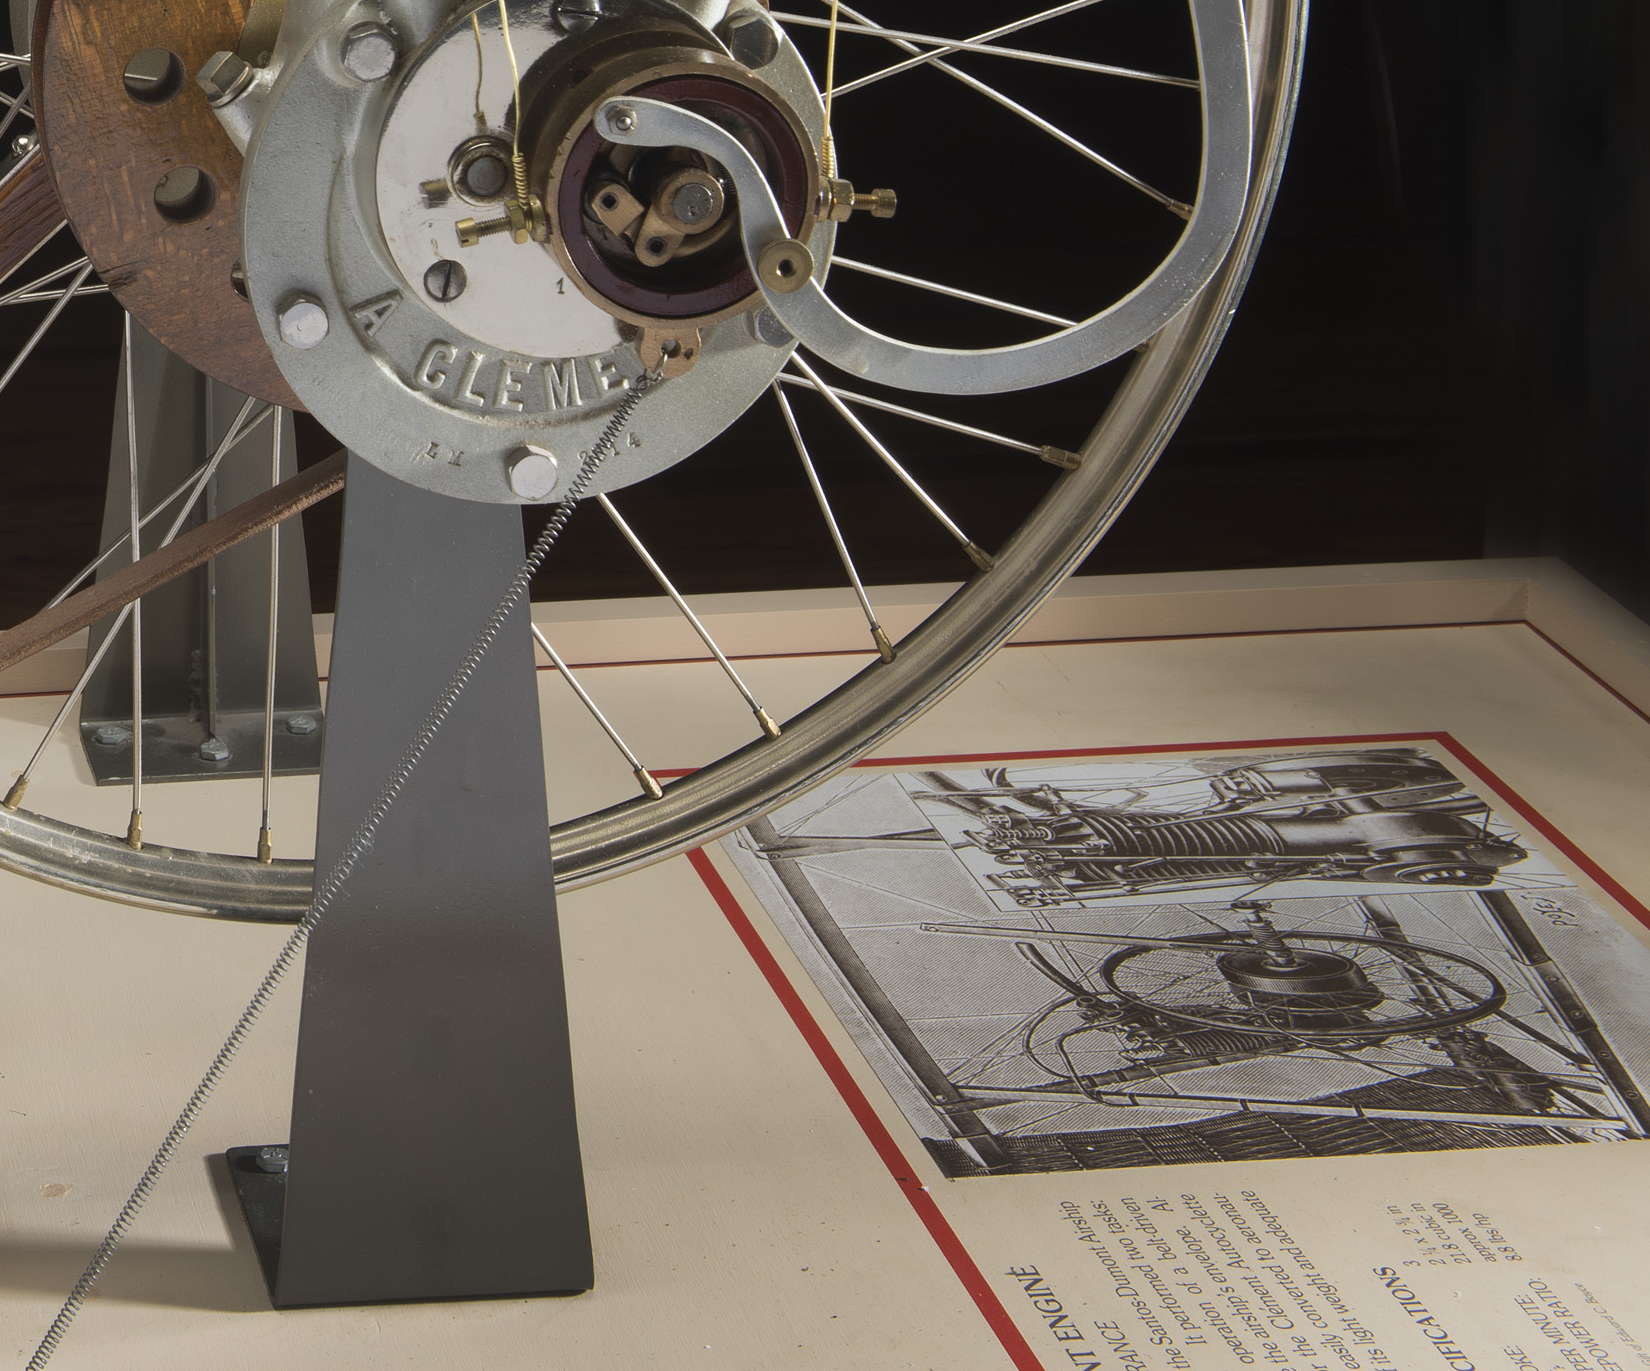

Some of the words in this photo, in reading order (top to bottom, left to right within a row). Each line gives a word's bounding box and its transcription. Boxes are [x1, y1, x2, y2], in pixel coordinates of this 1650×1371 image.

[350, 288, 404, 337] A
[414, 337, 631, 412] CLEME
[1090, 1199, 1126, 1235] tasks:
[1146, 1196, 1175, 1212] Al-
[1213, 1192, 1262, 1244] aeronau-
[1240, 1190, 1295, 1246] adequate
[1386, 1205, 1403, 1215] in
[1410, 1202, 1427, 1213] in
[1432, 1202, 1464, 1225] 1000
[1059, 1201, 1102, 1243] Airship
[1120, 1197, 1178, 1261] belt-driven
[1180, 1193, 1251, 1270] Autocyclette
[1420, 1214, 1451, 1241] cubic
[1472, 1212, 1508, 1244] lbs/hp
[1118, 1237, 1145, 1261] two
[1175, 1225, 1228, 1284] envelope.
[1255, 1248, 1275, 1261] to
[1414, 1237, 1429, 1245] x
[1441, 1243, 1473, 1265] 21.8
[1458, 1227, 1499, 1263] approx
[1497, 1246, 1524, 1262] 8.8
[1173, 1267, 1189, 1275] a
[1279, 1247, 1316, 1271] and
[1402, 1259, 1422, 1267] 3
[1428, 1258, 1448, 1266] 2
[1008, 1264, 1085, 1342] ENGINE
[1088, 1246, 1173, 1346] Santos-Dumont
[1130, 1264, 1202, 1331] performed
[1175, 1282, 1203, 1295] of
[1239, 1275, 1295, 1330] Clément
[1261, 1264, 1329, 1329] converted
[1302, 1272, 1351, 1315] weight
[1528, 1277, 1574, 1318] RATIO:
[1198, 1301, 1255, 1365] operation
[1338, 1316, 1376, 1345] light
[1513, 1294, 1571, 1345] MINUTE:
[1184, 1334, 1209, 1345] It
[1262, 1341, 1289, 1364] the
[1290, 1335, 1317, 1358] the
[1320, 1333, 1362, 1370] easily
[1165, 1348, 1191, 1370] the
[1367, 1348, 1392, 1365] its
